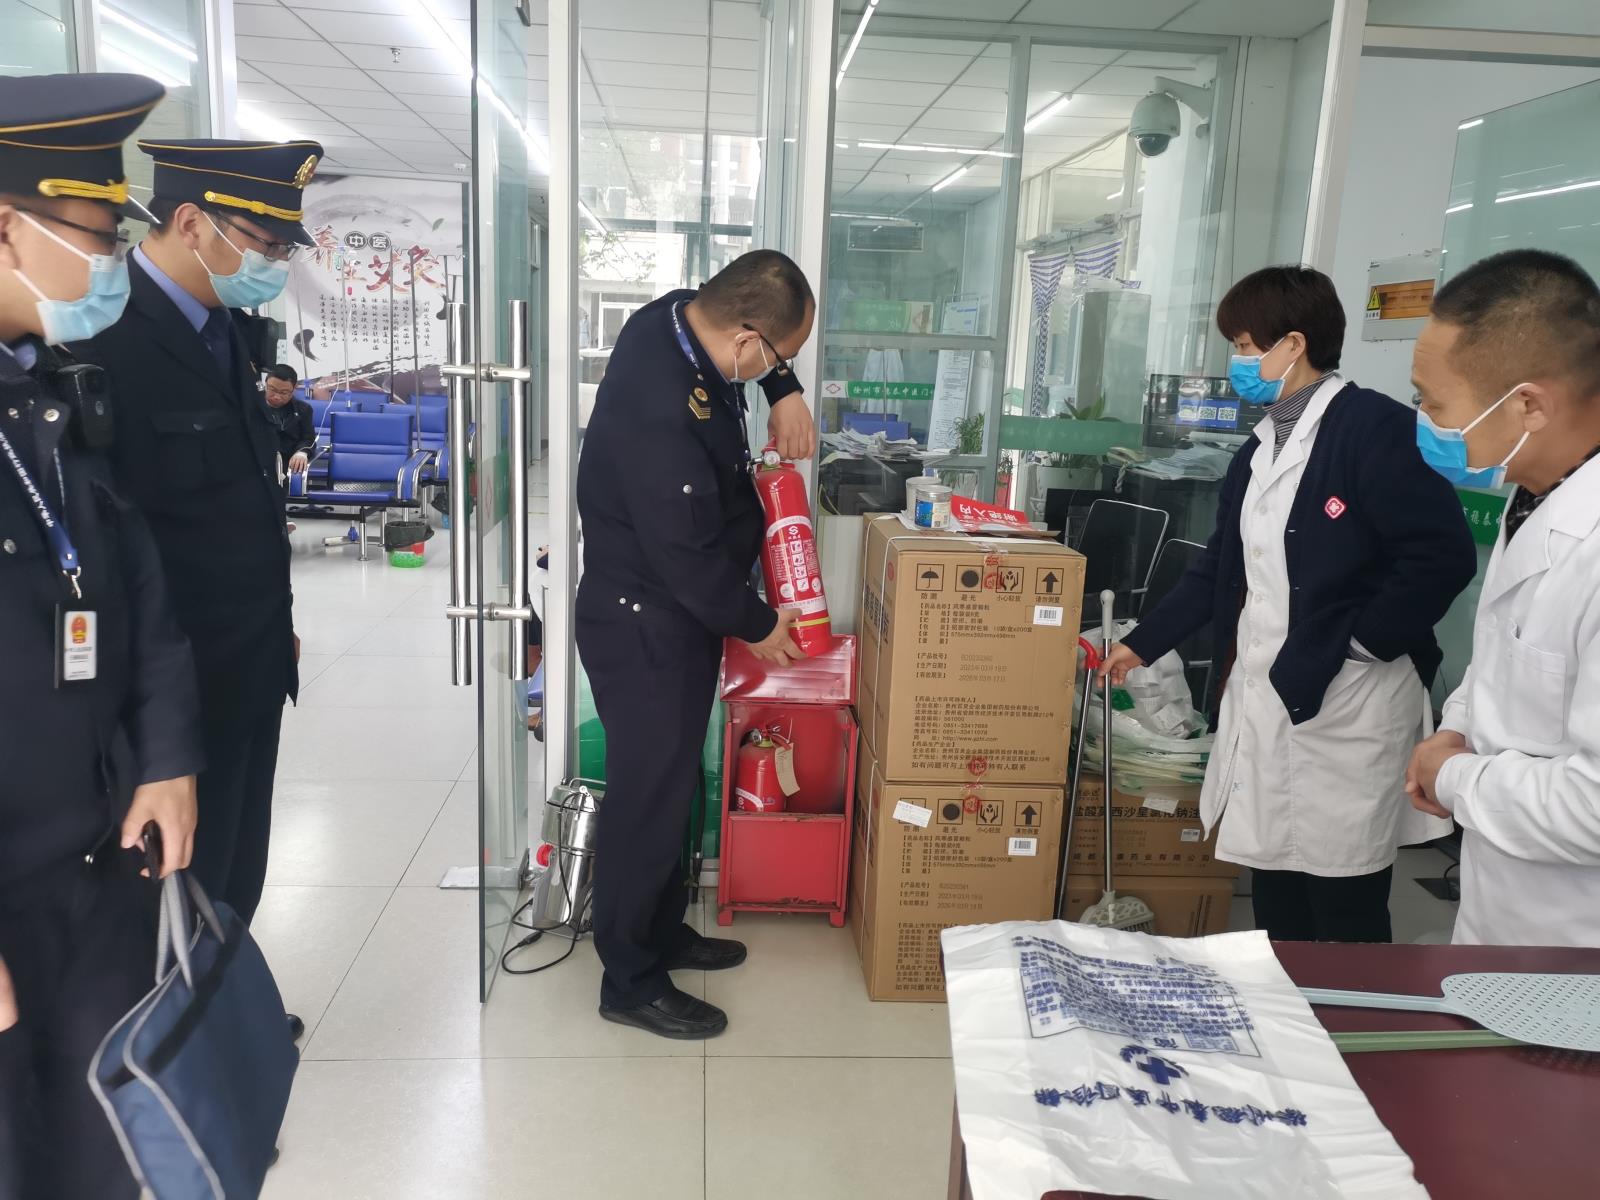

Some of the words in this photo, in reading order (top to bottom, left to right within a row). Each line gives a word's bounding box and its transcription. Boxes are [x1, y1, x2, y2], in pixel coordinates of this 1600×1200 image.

[344, 231, 392, 251] 中医
[959, 503, 1018, 522] 谢绝入内
